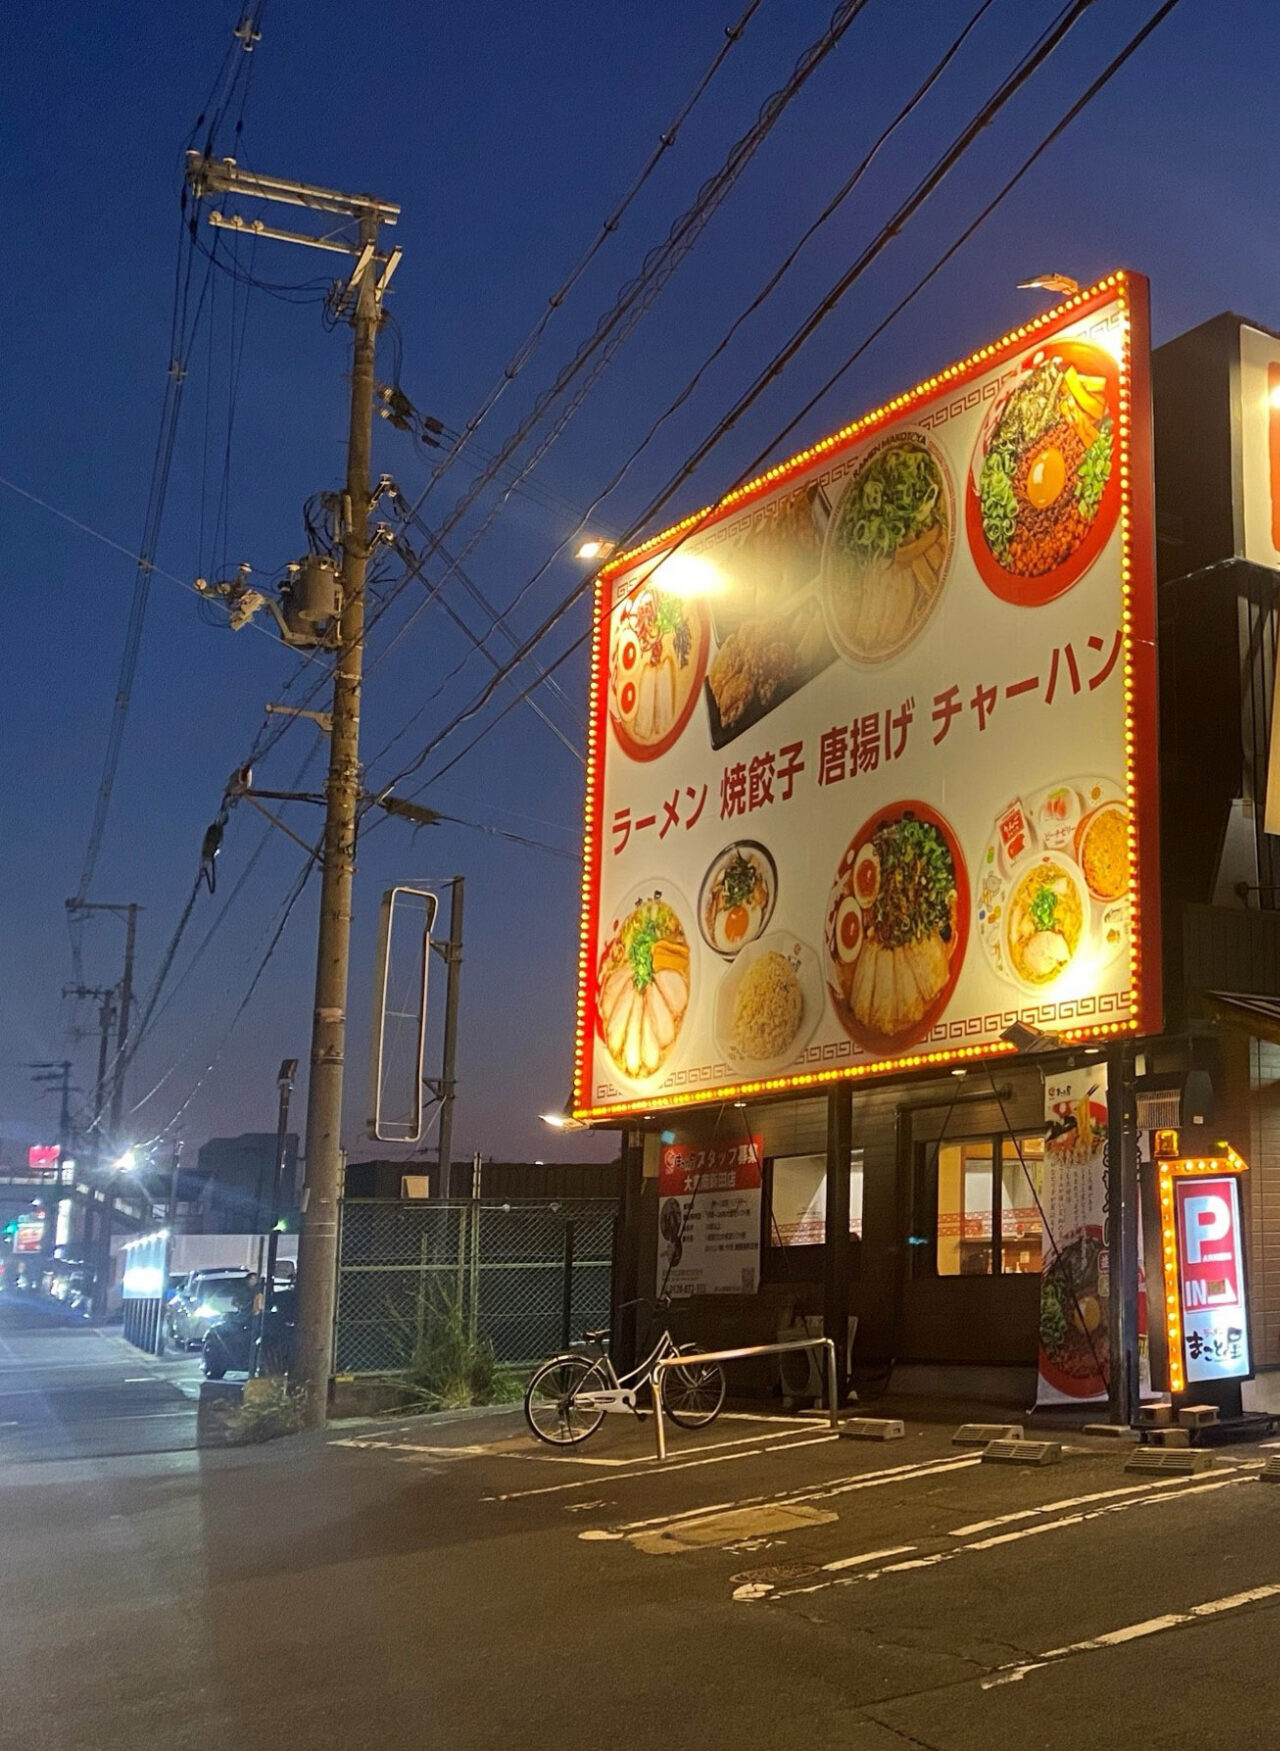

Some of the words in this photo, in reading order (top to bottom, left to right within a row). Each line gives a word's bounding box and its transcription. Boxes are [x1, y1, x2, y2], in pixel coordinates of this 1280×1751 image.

[612, 784, 708, 855] ラーメン
[720, 741, 805, 820] 焼餃子
[818, 696, 916, 787] 唐揚げ
[931, 629, 1123, 746] チャーハン
[1185, 1279, 1207, 1306] IN
[1186, 1327, 1242, 1361] まこと屋
